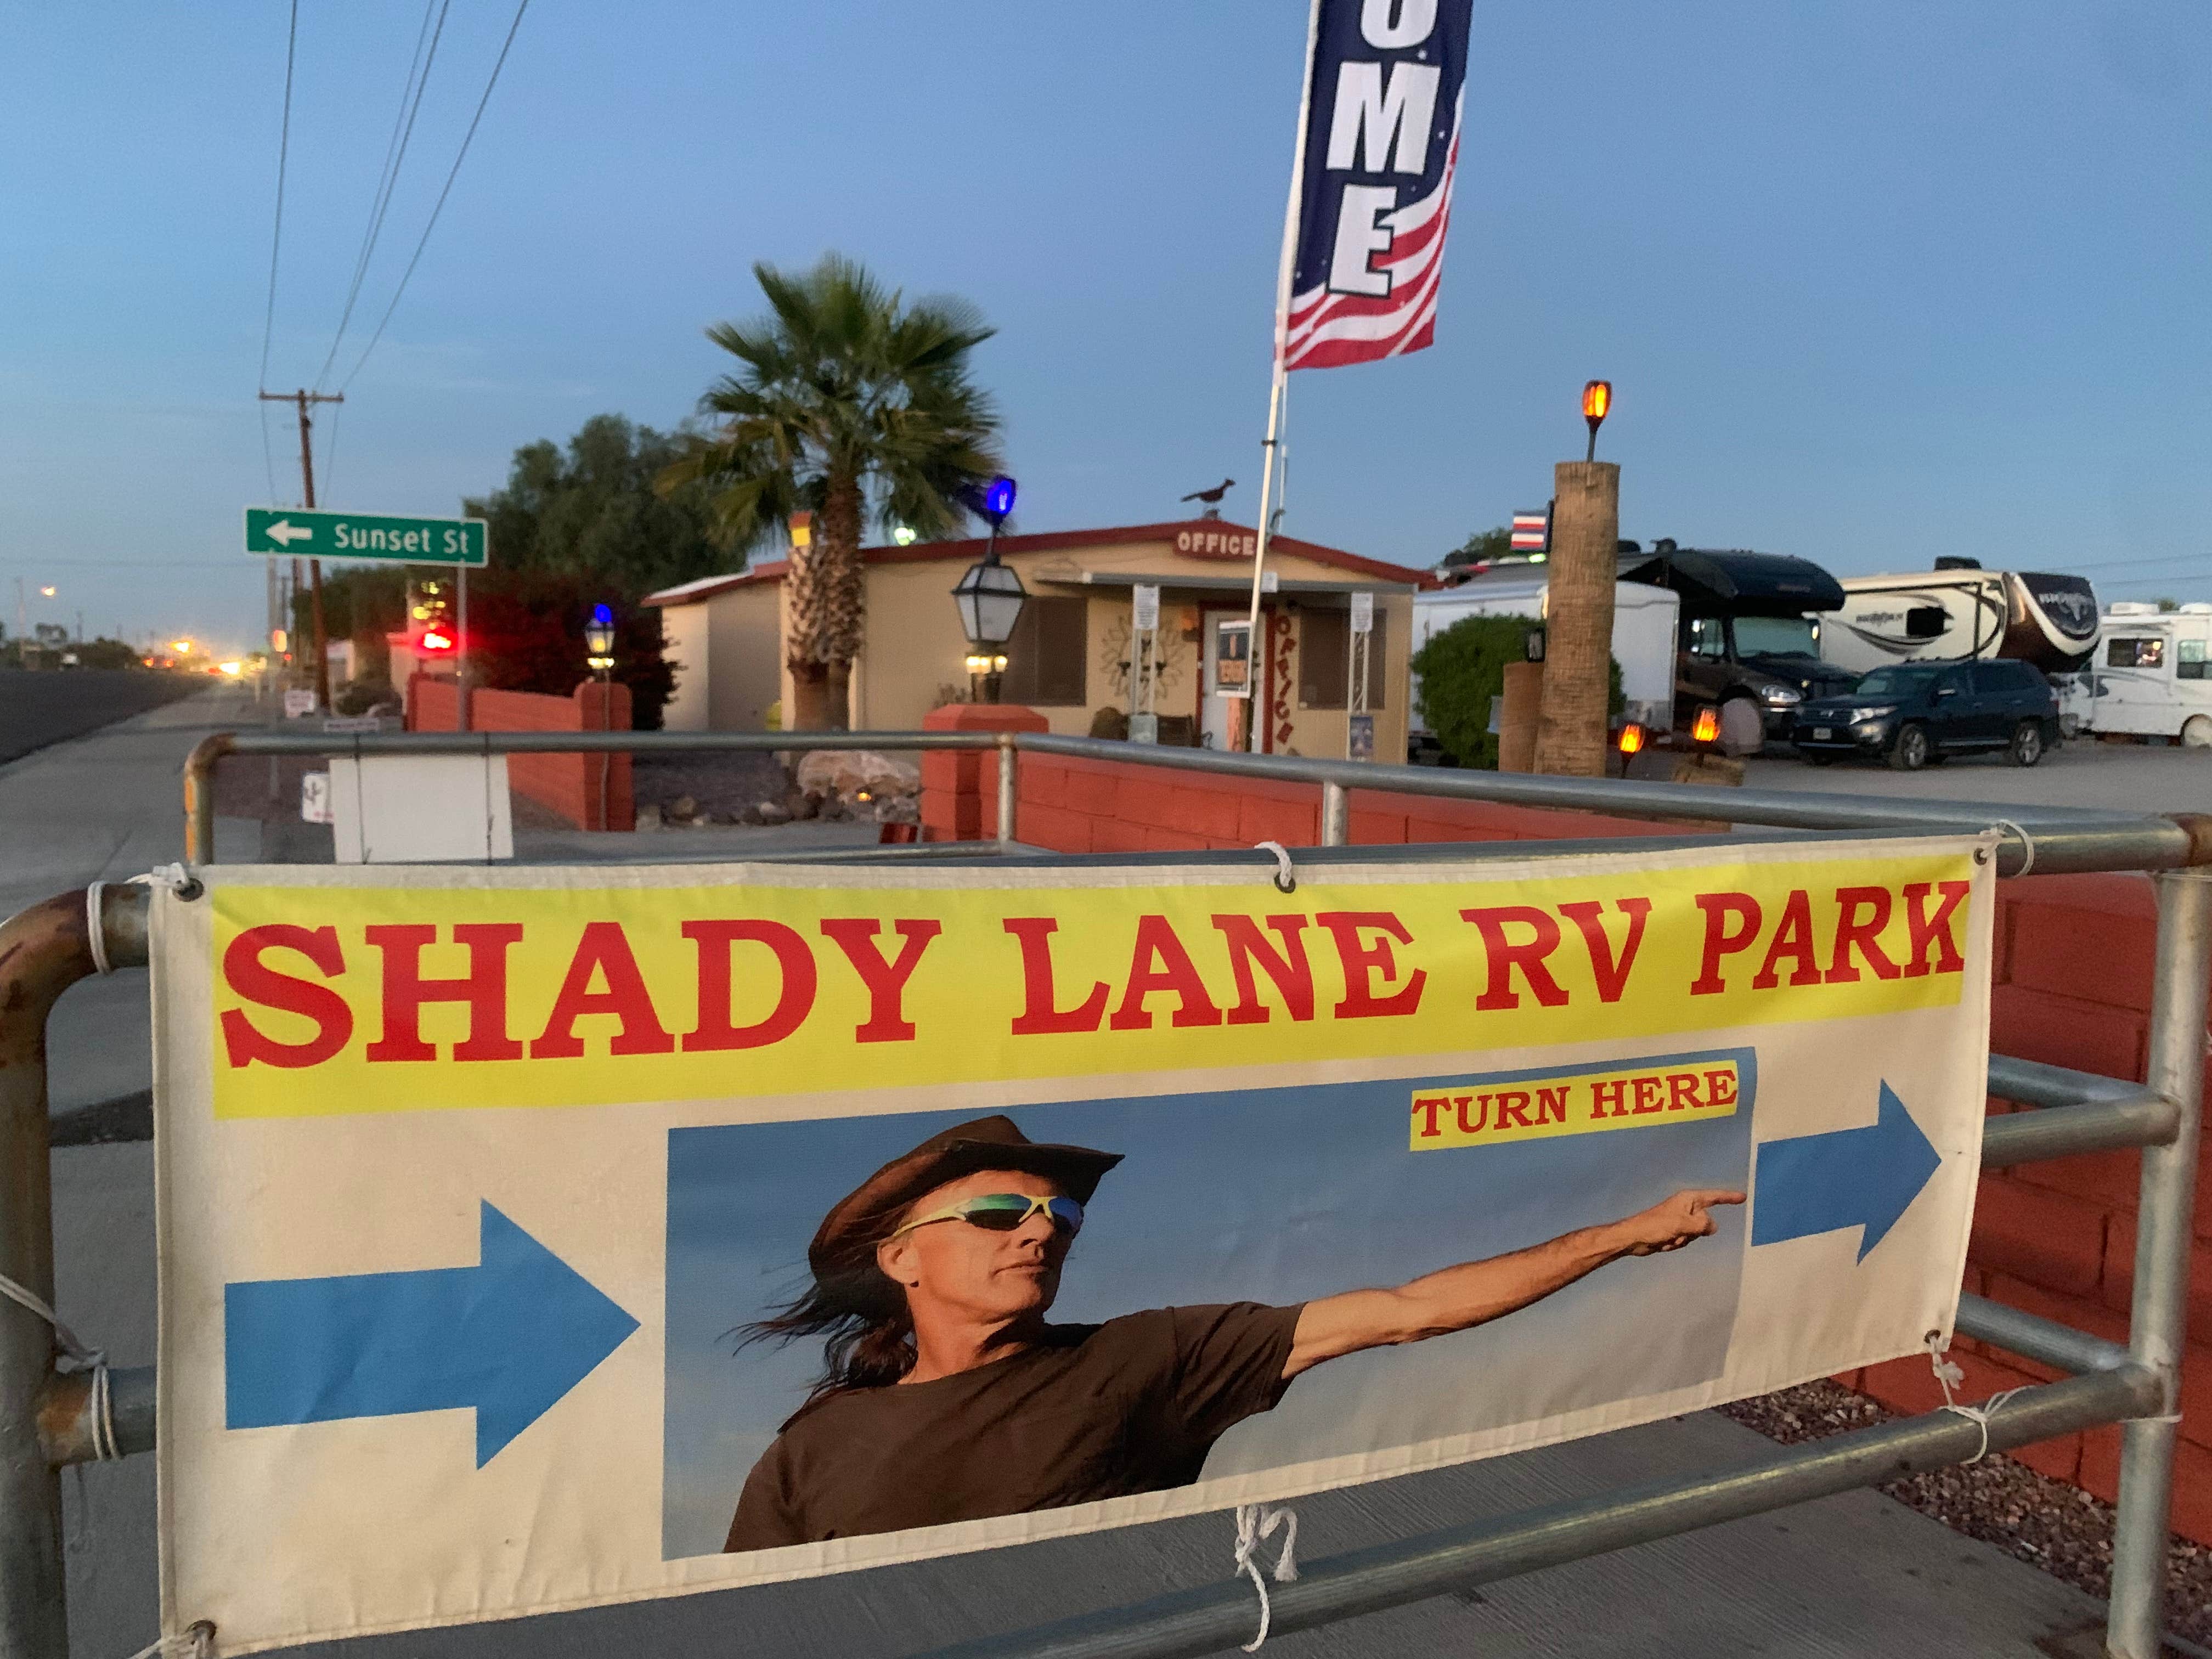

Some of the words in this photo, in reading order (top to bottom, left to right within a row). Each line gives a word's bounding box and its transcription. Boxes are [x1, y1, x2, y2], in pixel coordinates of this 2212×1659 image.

[335, 523, 431, 553] Sunset
[443, 529, 469, 555] St
[1177, 532, 1255, 556] OFFICE
[221, 918, 942, 1068] SHADY
[1002, 911, 1427, 1035] LANE
[1458, 897, 1652, 1011] RV
[1690, 880, 1970, 996] PARK
[1412, 1086, 1571, 1137] TURN
[1590, 1069, 1737, 1119] HERE
